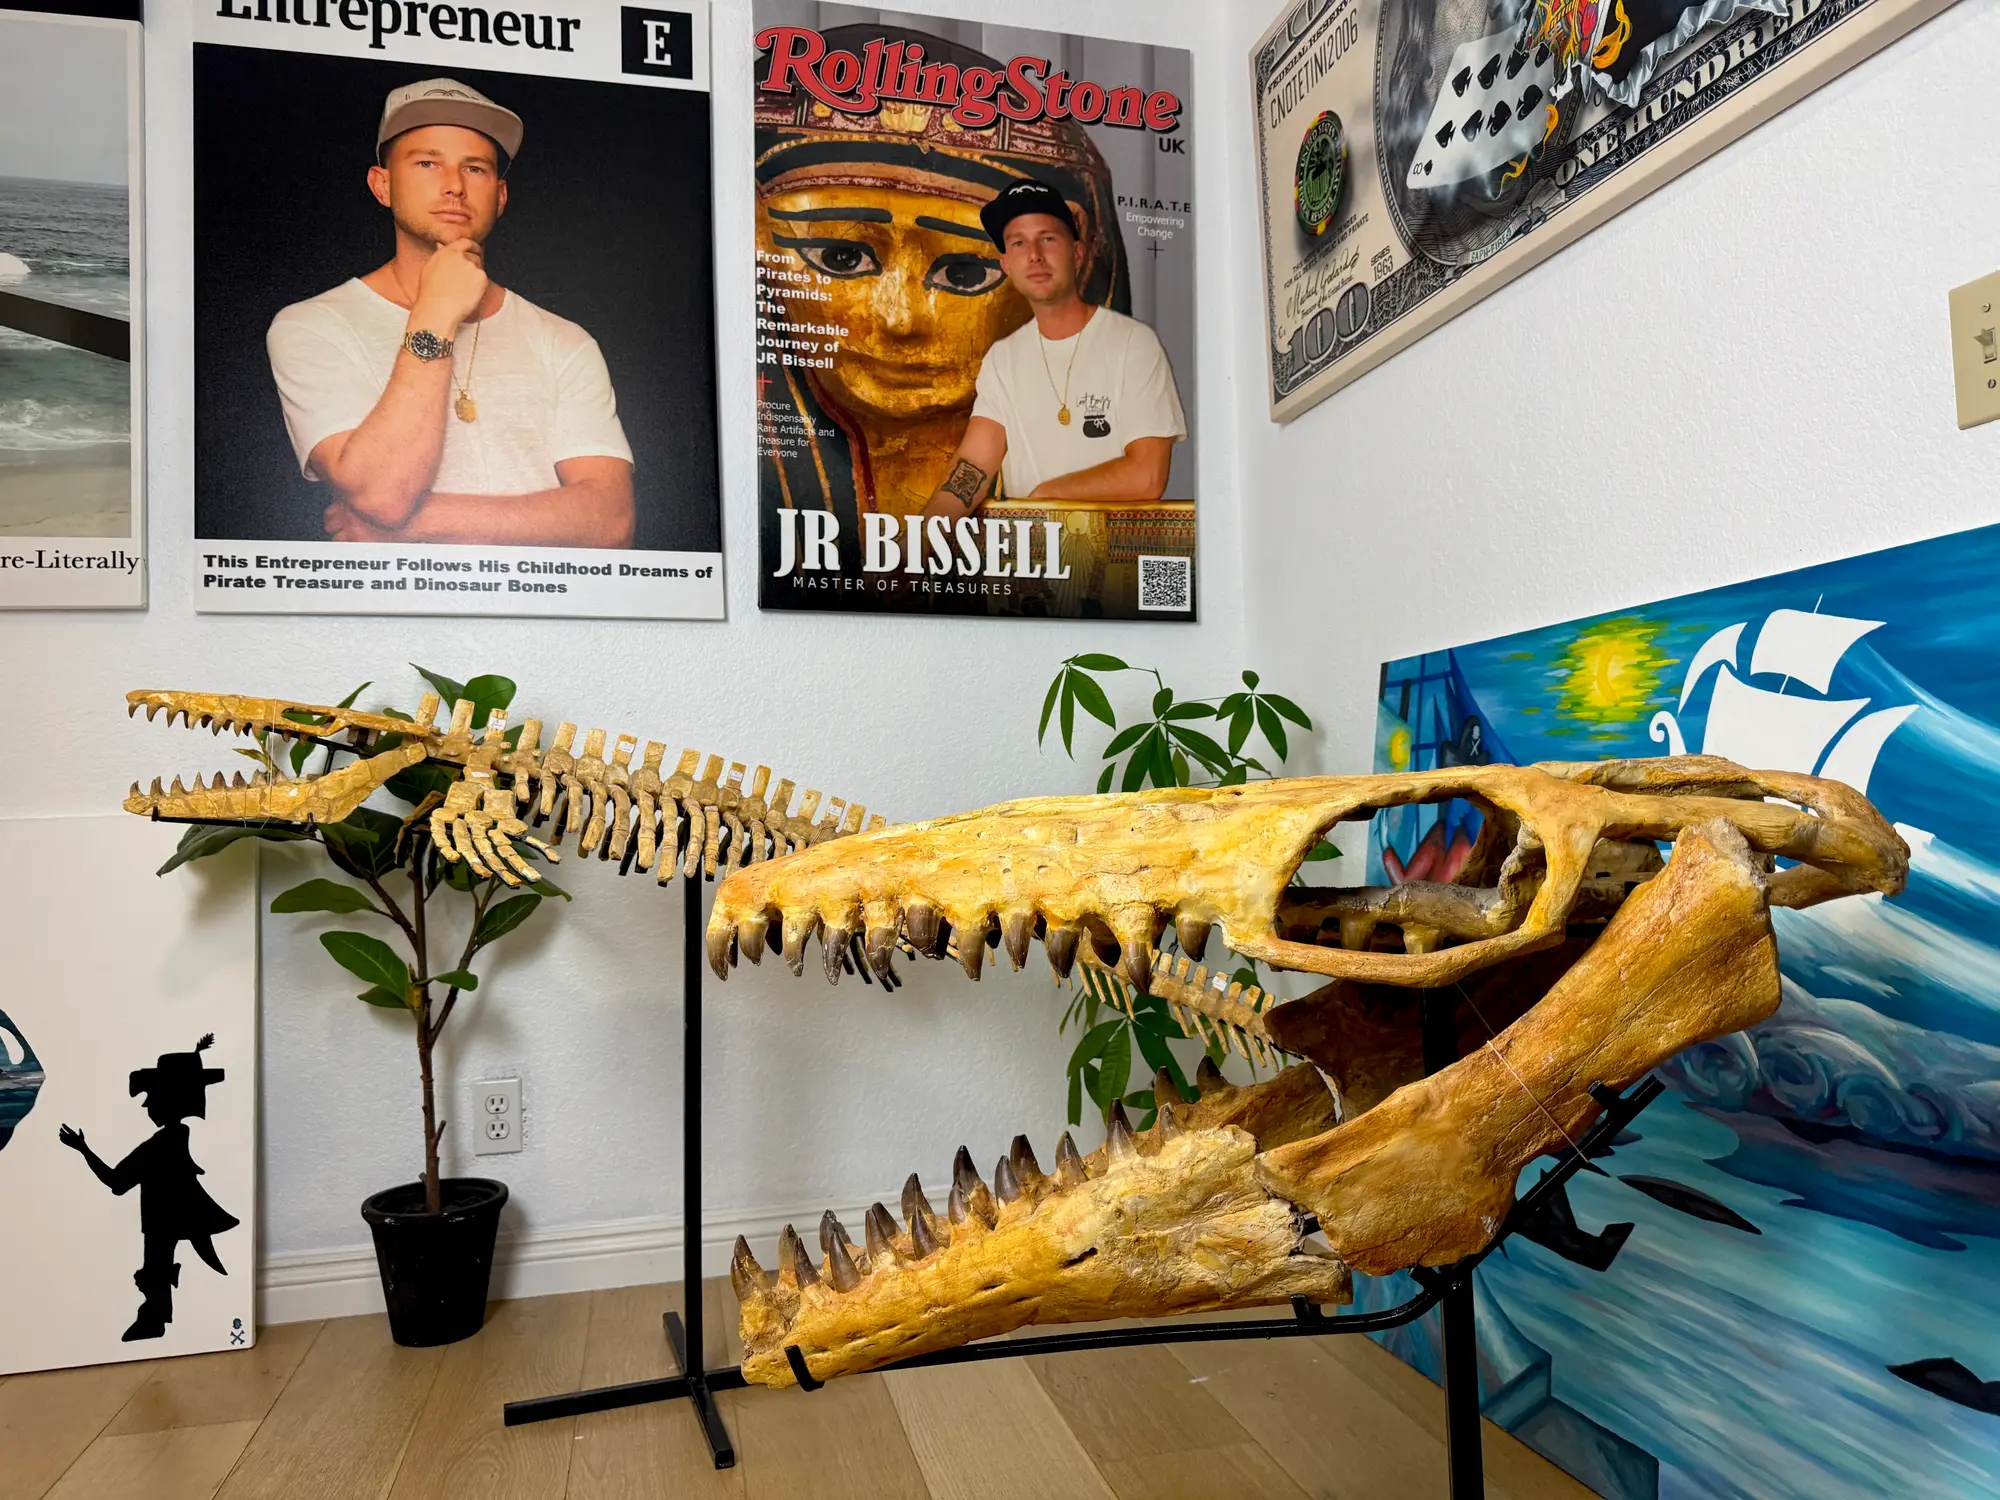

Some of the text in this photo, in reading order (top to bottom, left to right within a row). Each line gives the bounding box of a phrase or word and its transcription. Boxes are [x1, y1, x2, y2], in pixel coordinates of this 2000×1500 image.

[1308, 0, 1353, 50] RESERV
[643, 20, 671, 66] E
[1158, 138, 1185, 155] UK
[1555, 127, 1621, 189] ONE
[1126, 212, 1185, 229] Empowering
[1137, 226, 1173, 240] Change
[756, 250, 795, 264] From
[756, 267, 832, 285] Pirates to
[1373, 256, 1394, 282] 1963
[756, 284, 832, 301] Pyramids:
[756, 301, 786, 314] The
[756, 318, 849, 337] Remarkable
[1287, 281, 1372, 377] 100
[756, 335, 839, 353] Journey of
[756, 352, 834, 369] JR Bissell
[758, 400, 791, 411] Procure
[758, 424, 835, 437] Rare Artifacts and
[758, 435, 810, 447] Treasure for
[758, 447, 798, 458] Everyone
[773, 508, 1071, 580] JR BISSELL
[203, 554, 714, 579] This Entrepreneur Follows His Childhood Dreams of
[203, 574, 568, 593] Pirate Treasure and Dinosaur Bones
[793, 576, 1012, 595] MASTER OF TREASURES
